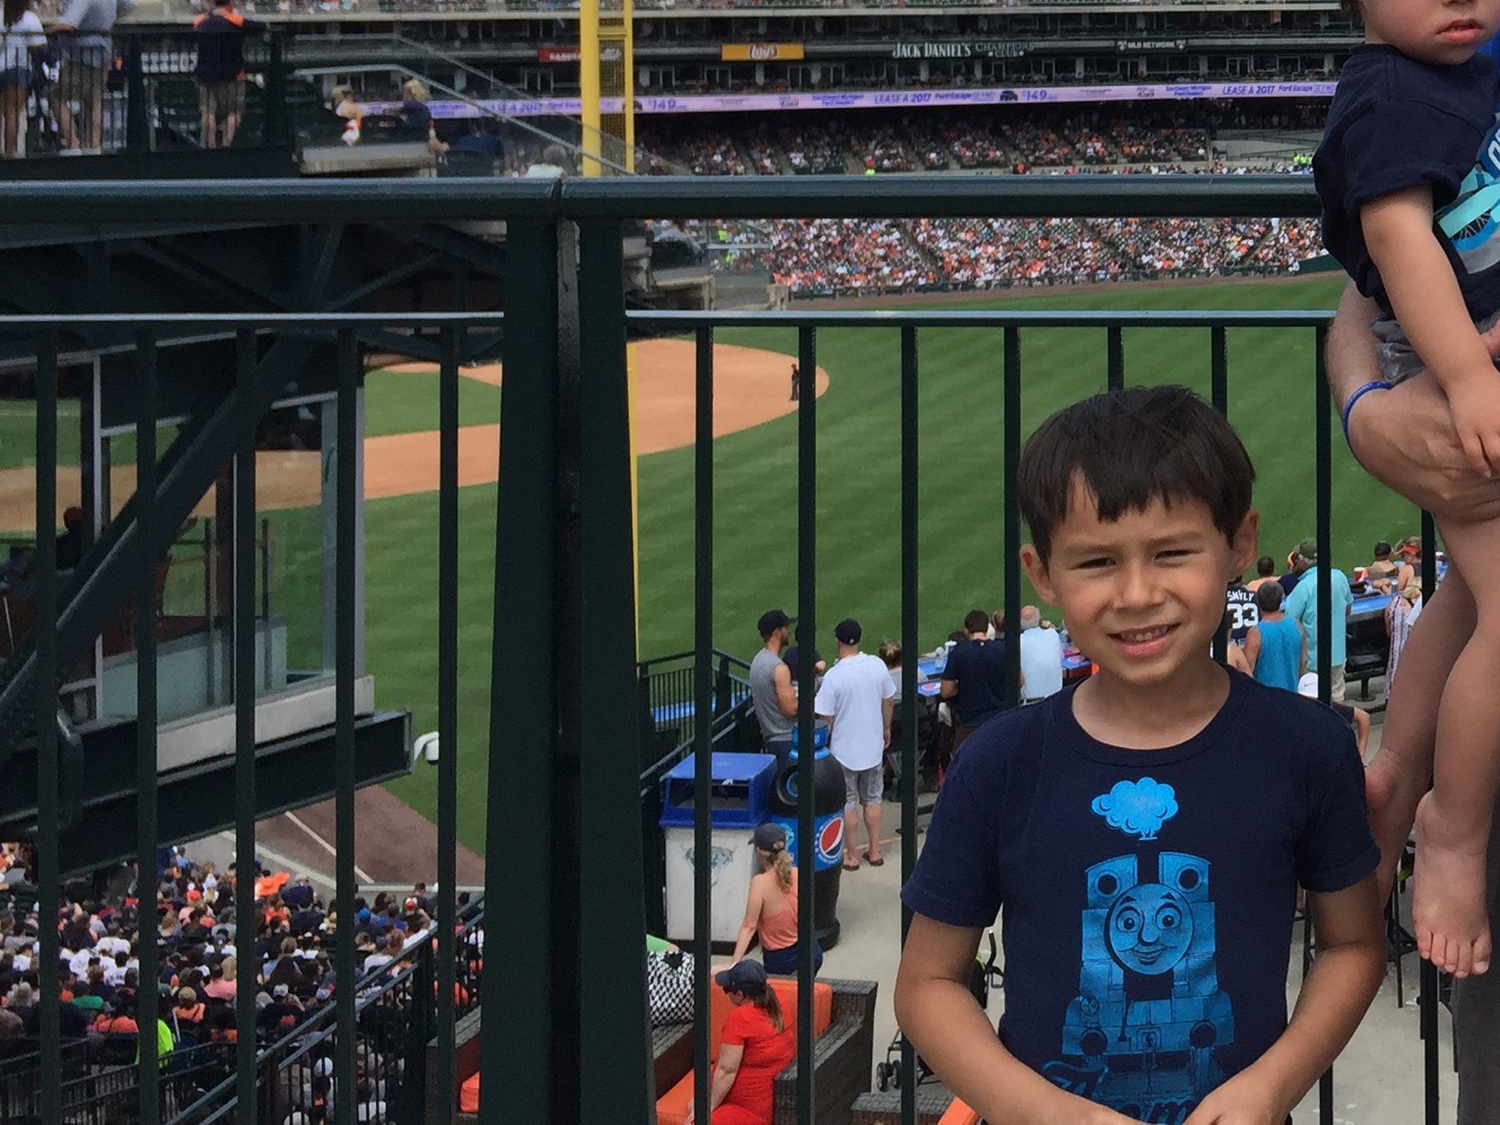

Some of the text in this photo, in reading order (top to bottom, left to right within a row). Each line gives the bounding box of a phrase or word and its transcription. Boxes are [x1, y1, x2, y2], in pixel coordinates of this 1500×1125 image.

[893, 42, 971, 58] JACK DANIEL'S
[1222, 85, 1248, 95] LEASE
[1256, 85, 1275, 94] 2017
[1227, 602, 1259, 629] 33
